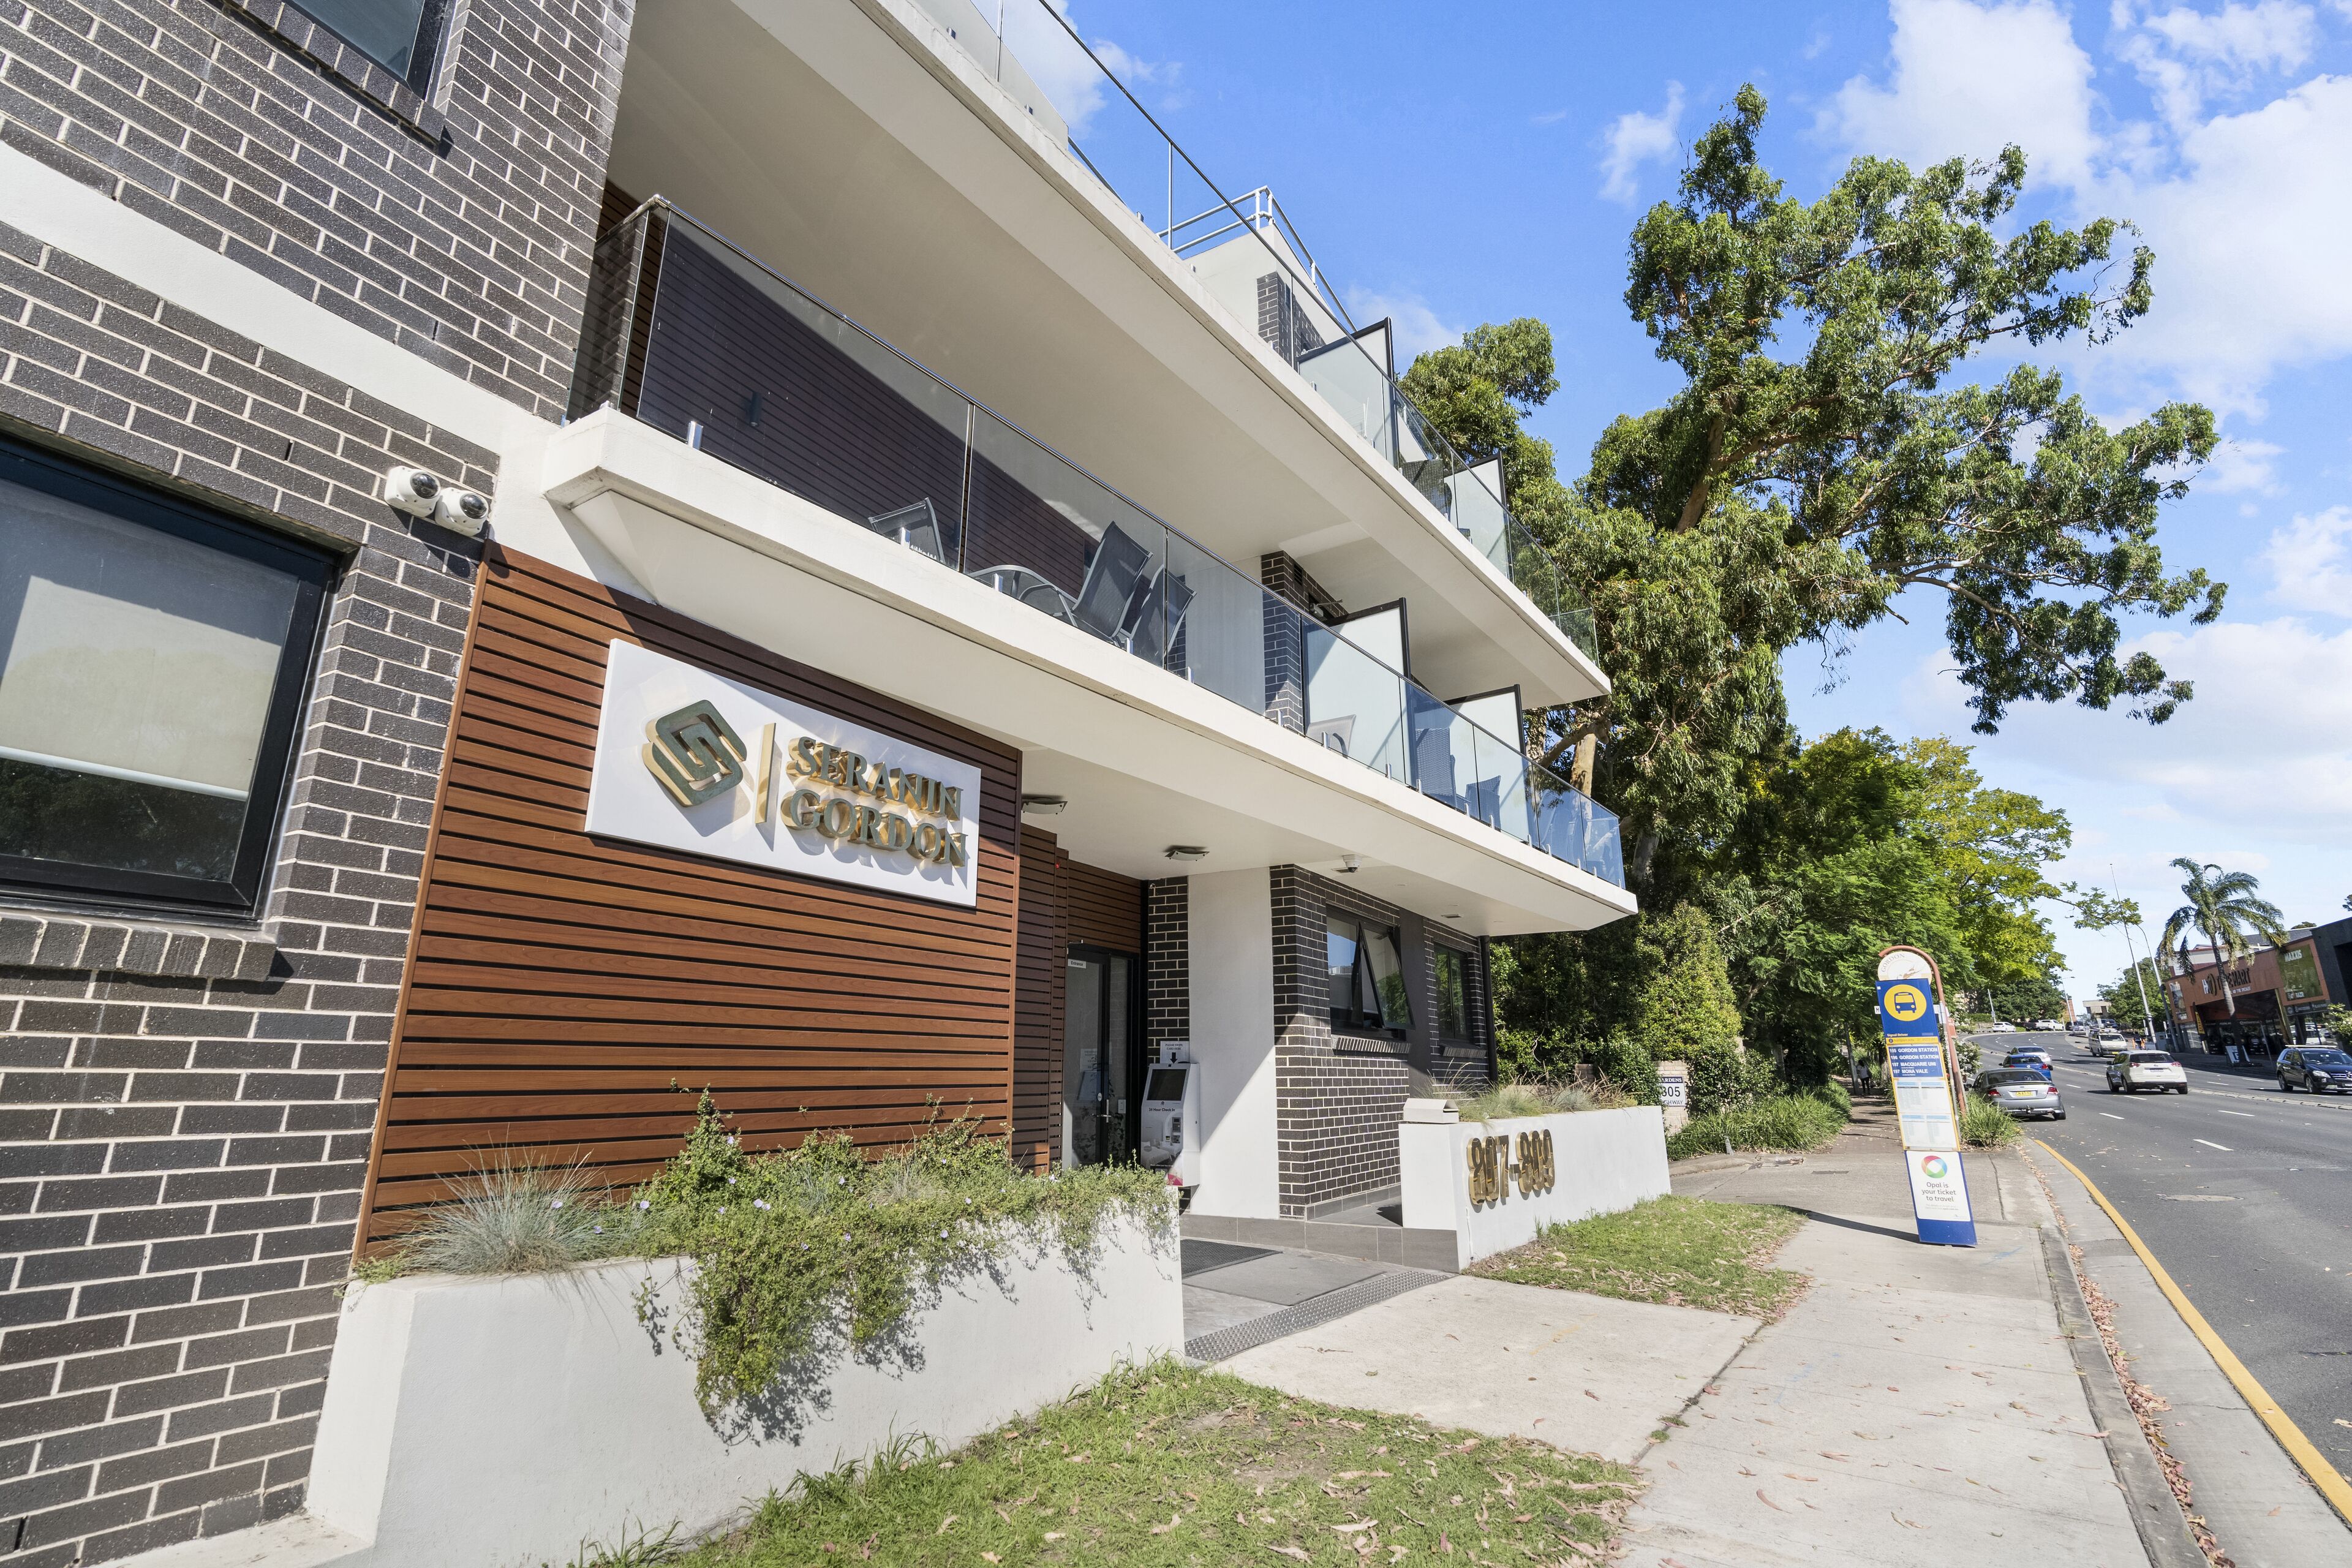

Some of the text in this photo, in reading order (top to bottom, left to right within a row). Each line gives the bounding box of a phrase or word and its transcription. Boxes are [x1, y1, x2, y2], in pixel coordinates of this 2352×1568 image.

[787, 736, 963, 822] SERANIN
[782, 790, 968, 867] GORDON
[1881, 954, 1905, 973] GORDON
[1467, 1129, 1555, 1205] 807-809
